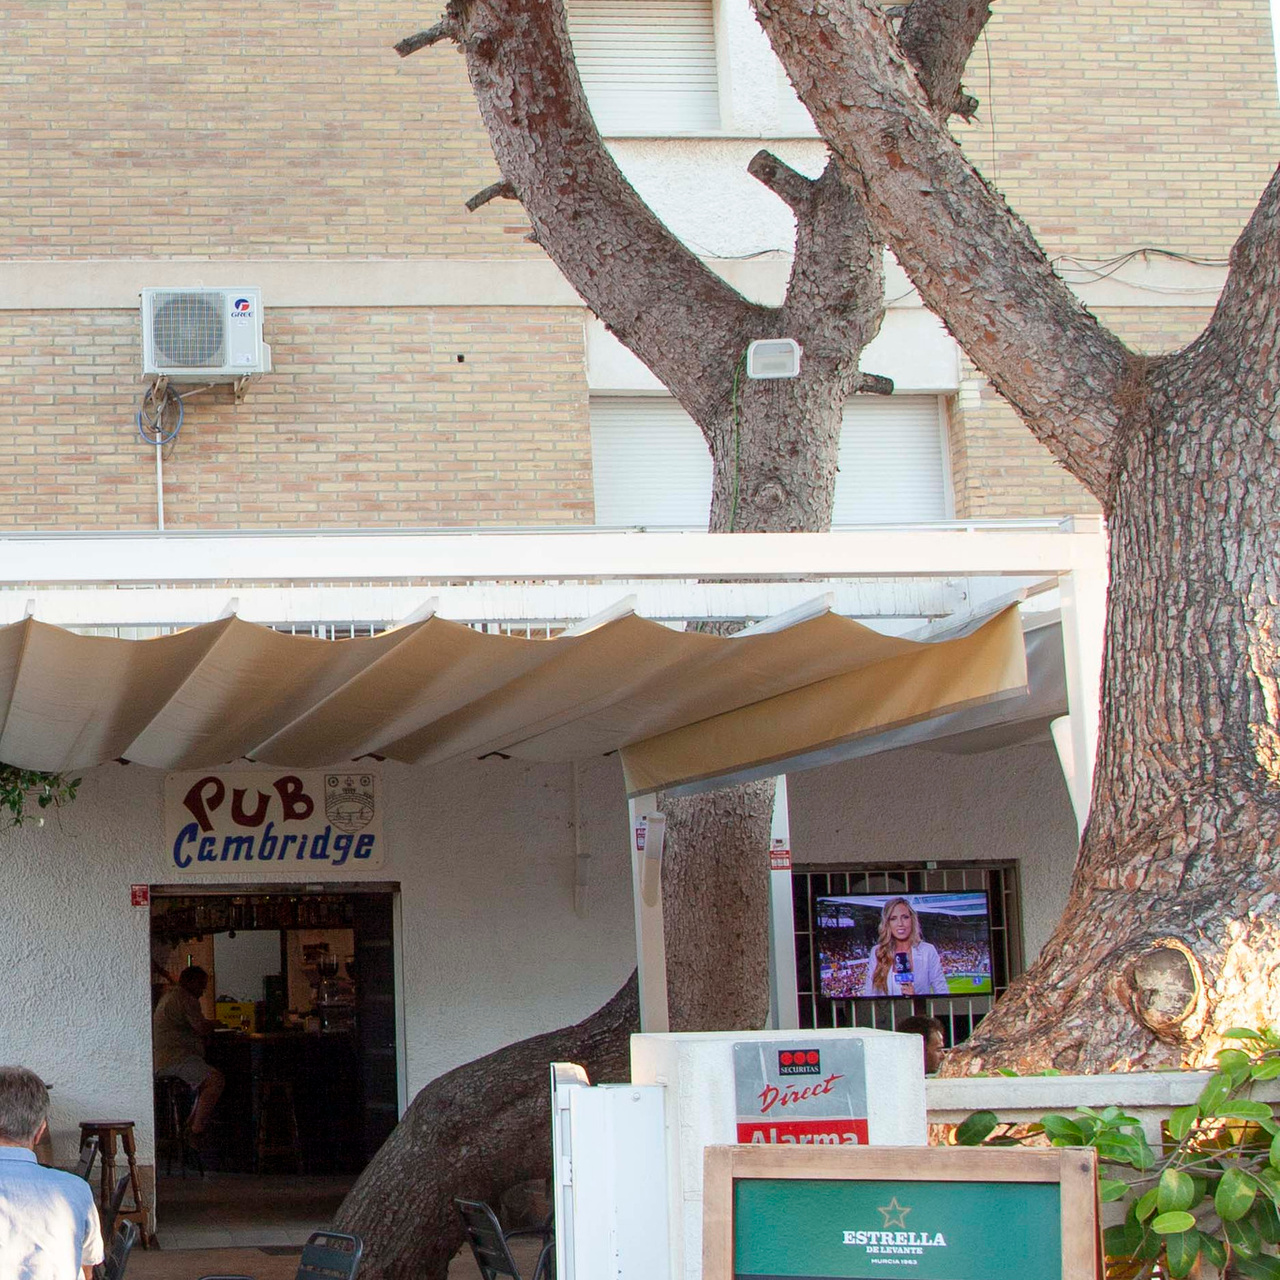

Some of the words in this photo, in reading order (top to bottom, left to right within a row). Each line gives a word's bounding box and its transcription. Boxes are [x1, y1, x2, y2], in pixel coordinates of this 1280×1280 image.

[183, 775, 315, 832] PUB
[173, 822, 375, 869] Cambridge
[780, 1066, 820, 1074] SECURITAS
[757, 1073, 846, 1114] Direct
[842, 1230, 947, 1246] ESTRELLA
[866, 1245, 879, 1253] DE
[880, 1246, 923, 1254] LEVANTE
